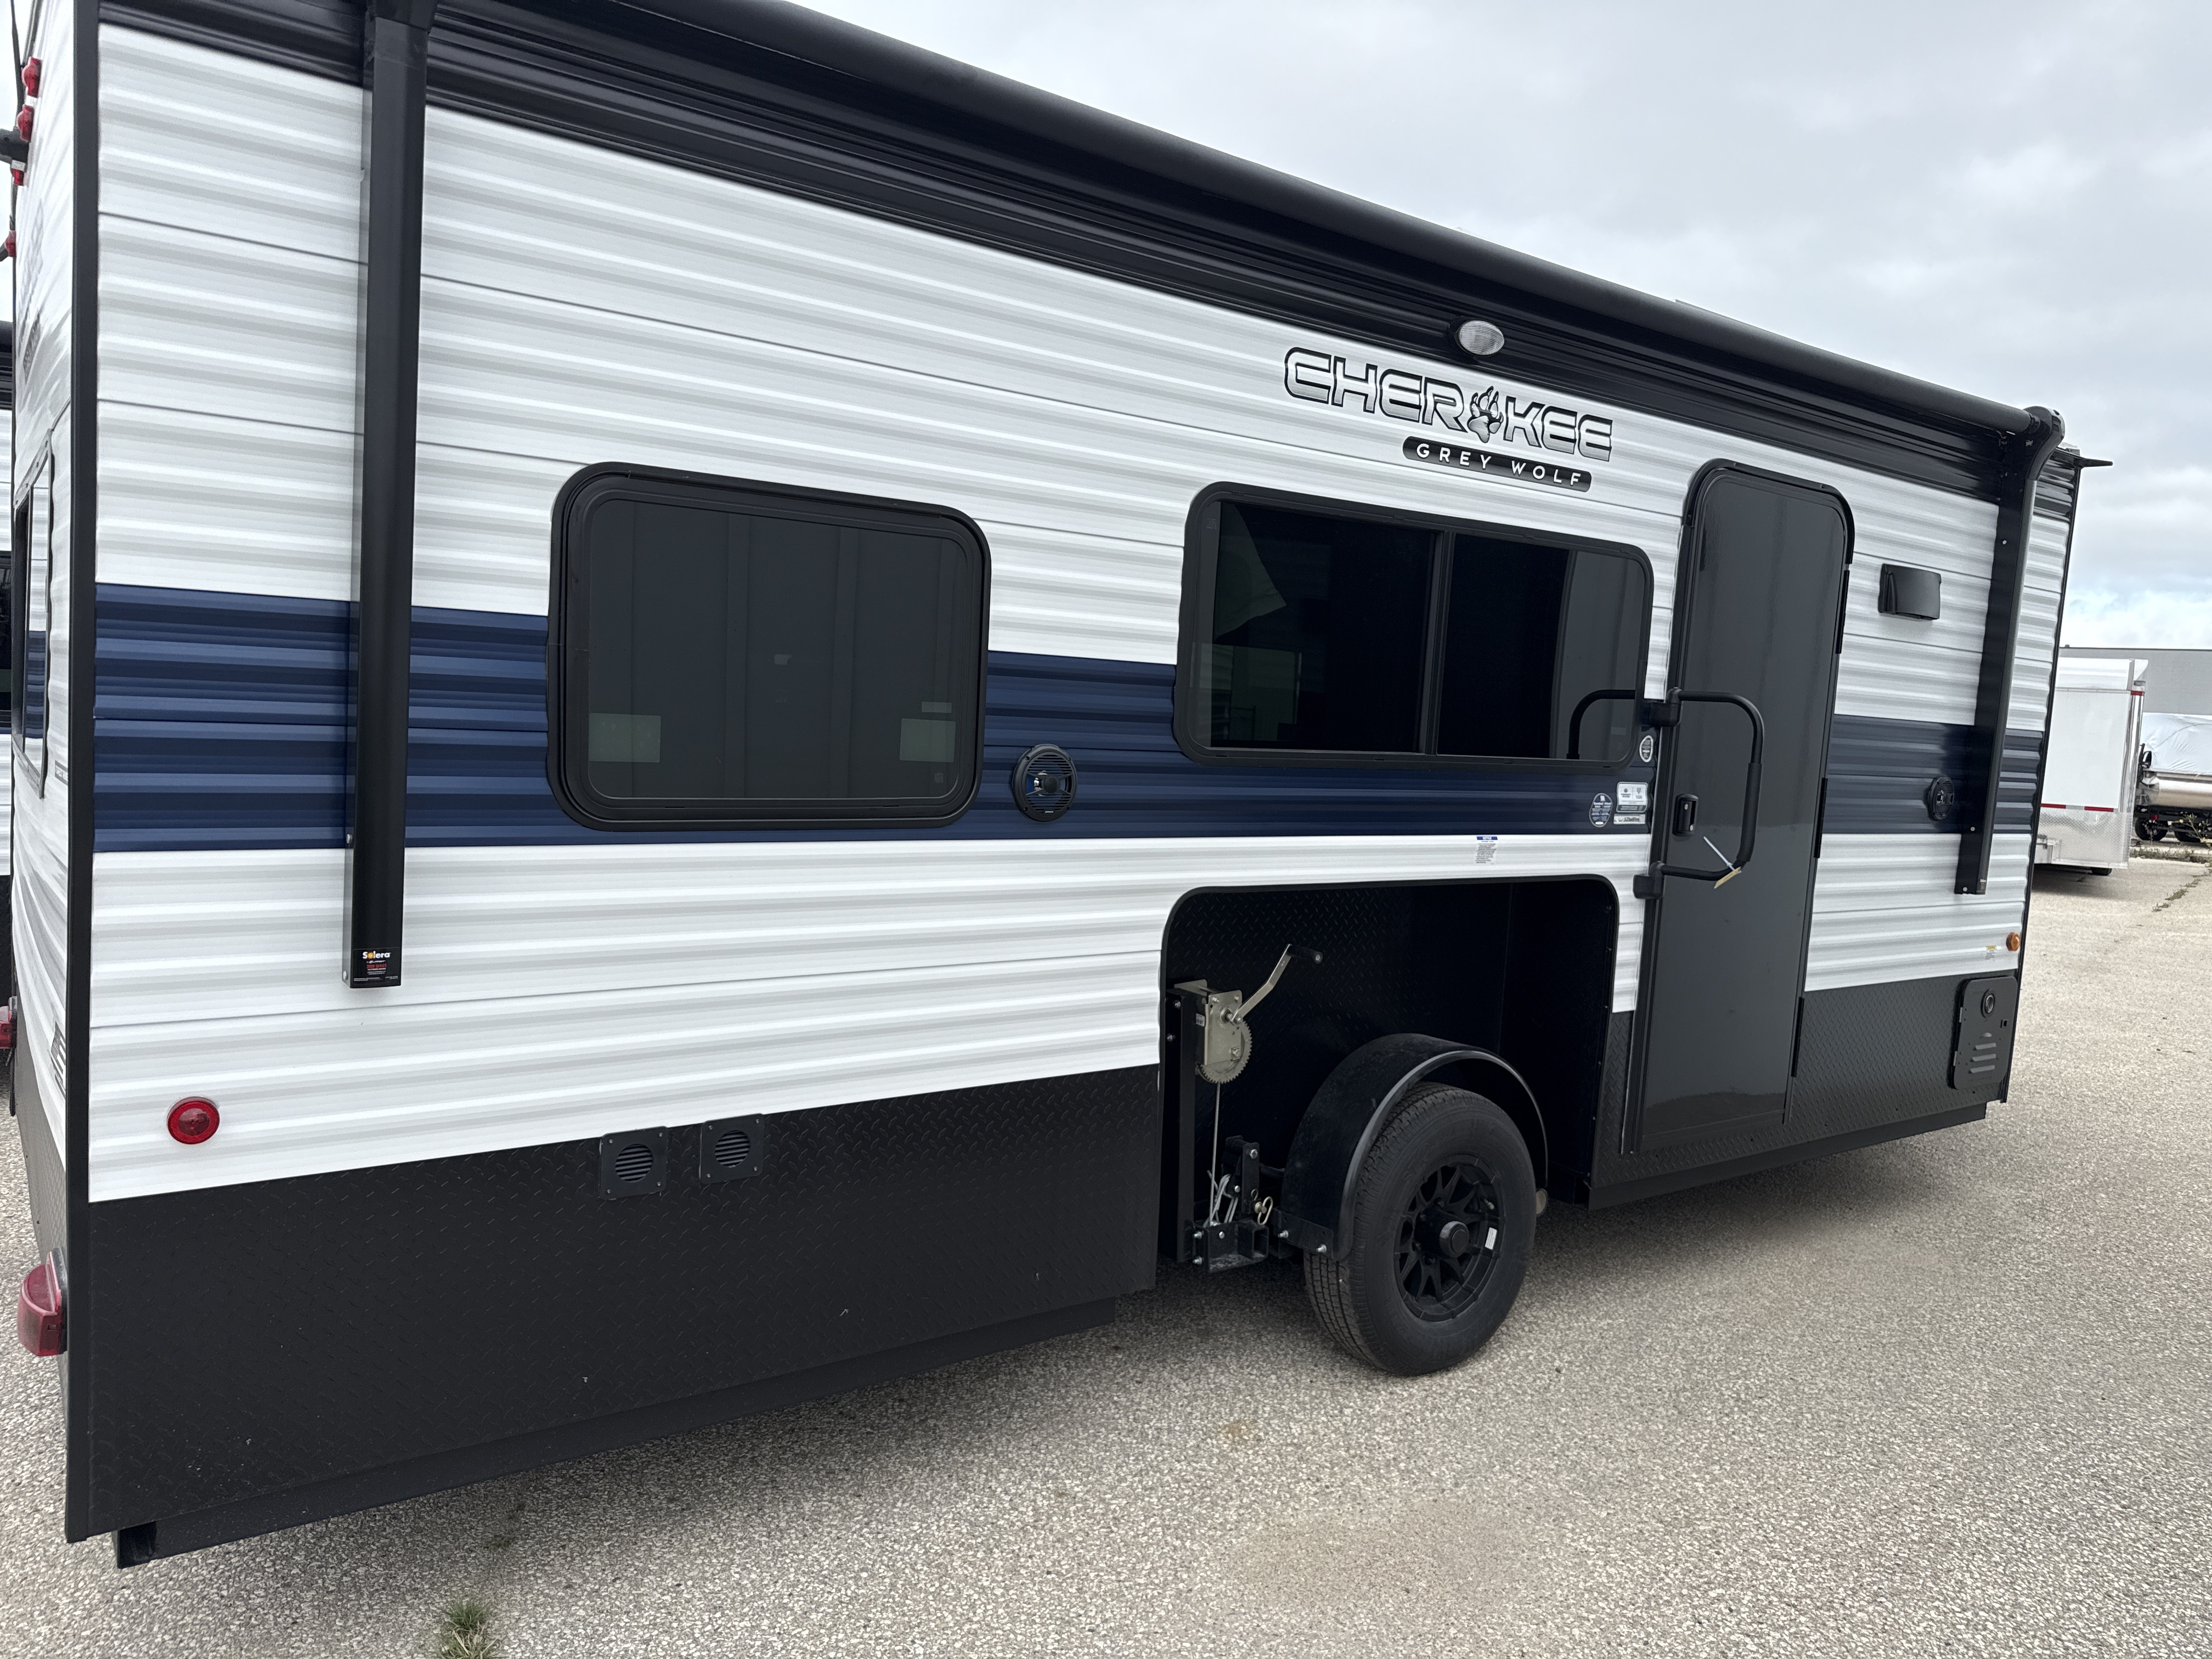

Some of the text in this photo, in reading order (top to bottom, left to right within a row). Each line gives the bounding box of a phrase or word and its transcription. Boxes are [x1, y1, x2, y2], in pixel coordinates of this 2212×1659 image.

[1284, 347, 1612, 461] CHEROKEE
[1417, 443, 1581, 486] GREY WOLF
[362, 951, 391, 959] Solera
